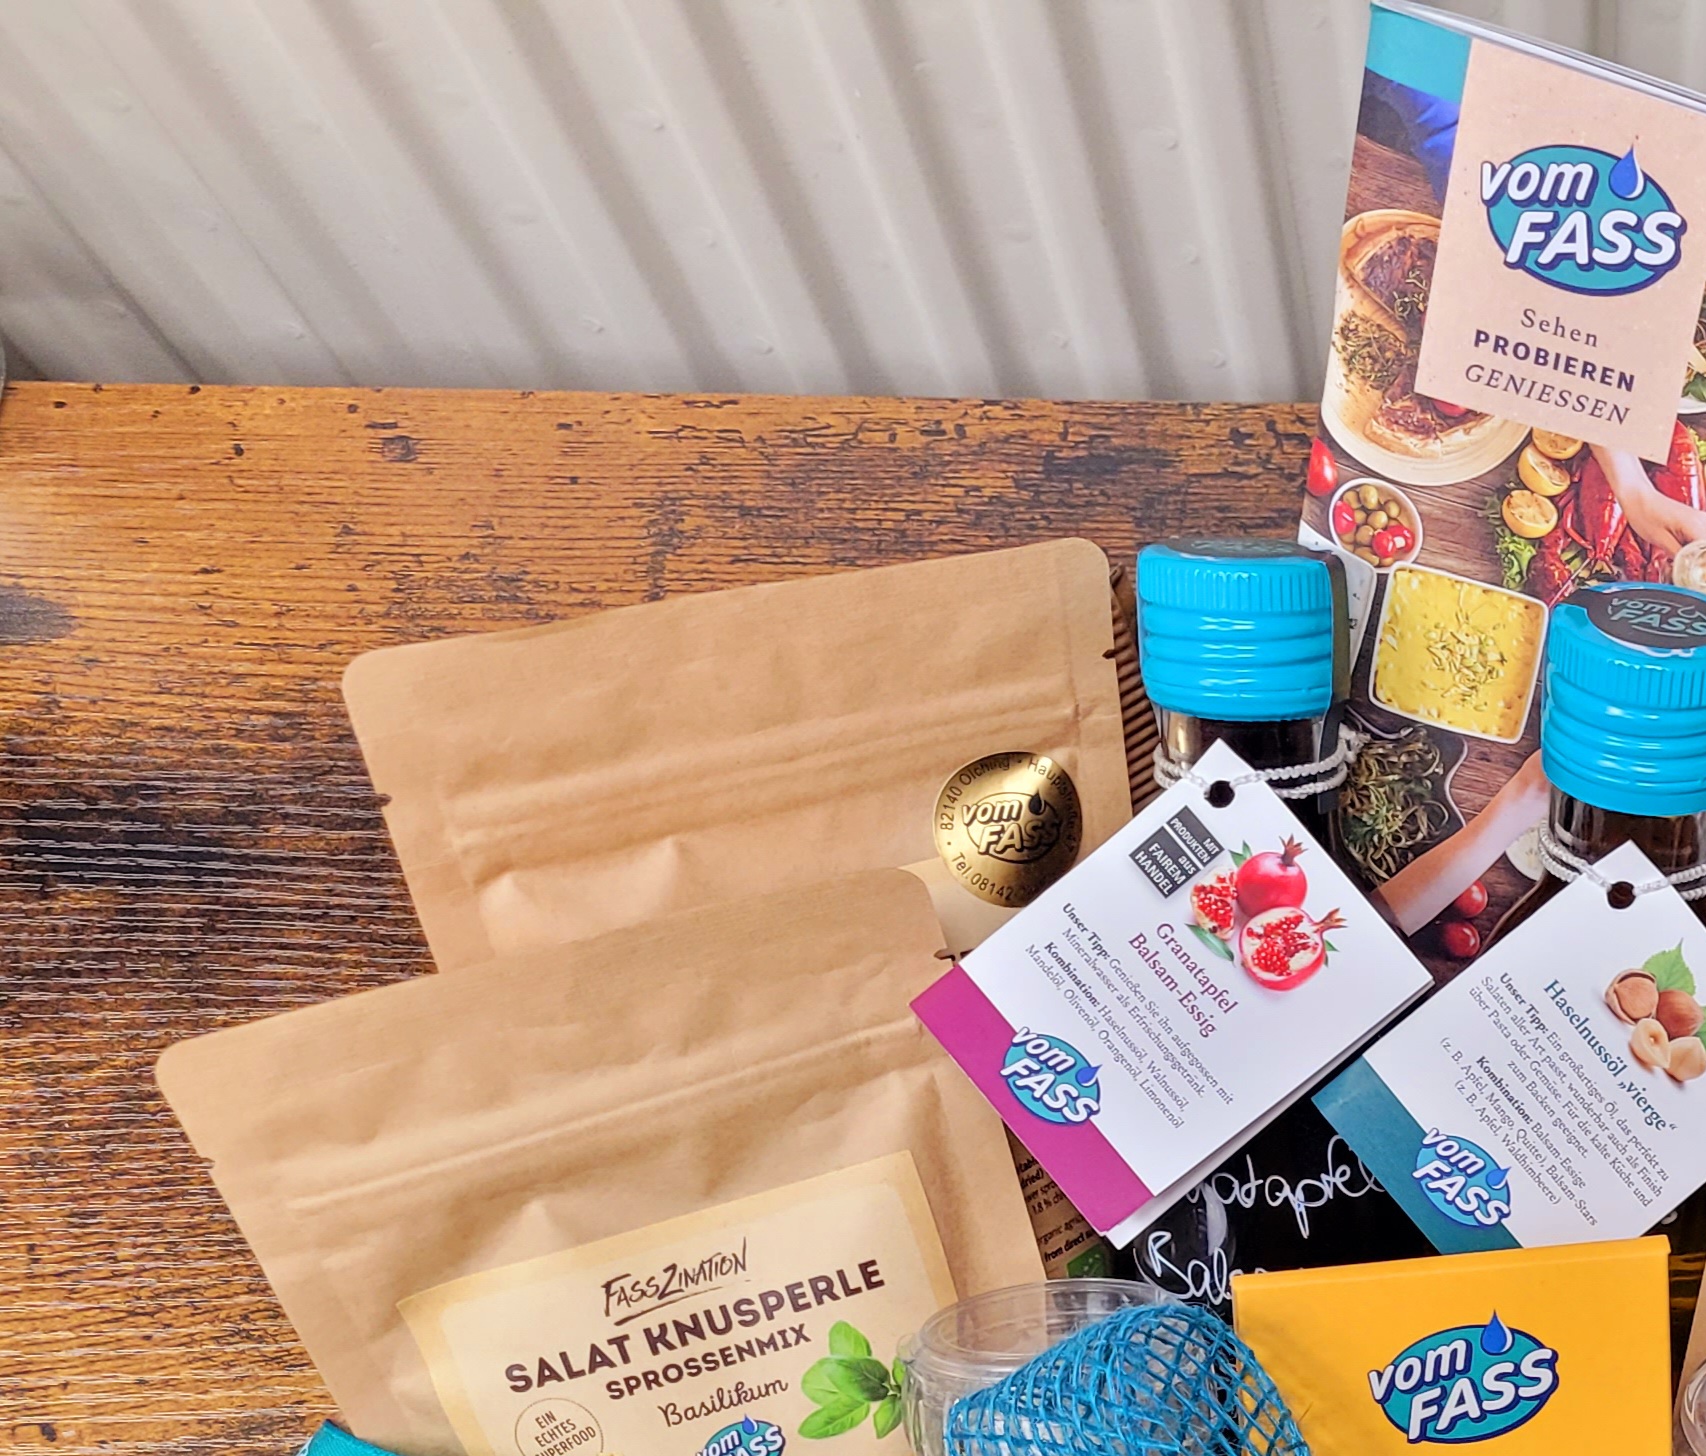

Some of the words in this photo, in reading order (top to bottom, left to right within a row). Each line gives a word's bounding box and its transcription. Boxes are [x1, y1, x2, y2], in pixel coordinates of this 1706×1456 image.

[1481, 161, 1598, 204] vom
[1505, 210, 1687, 270] FASS
[1521, 308, 1599, 348] Sehen
[1474, 330, 1635, 392] PROBIEREN
[1465, 364, 1631, 425] GENIESSEN
[1612, 598, 1671, 613] vom
[940, 786, 962, 830] 82140
[962, 800, 1023, 826] vom
[1148, 842, 1187, 885] FAIREM
[1169, 817, 1211, 863] PRODUKTEN
[1177, 855, 1197, 875] aus
[1202, 837, 1220, 855] MIT
[1134, 850, 1173, 895] HANDEL
[1061, 927, 1120, 994] Mineralwasser
[1115, 993, 1131, 1008] als
[1128, 932, 1217, 1039] Balsam-Essig
[1156, 923, 1239, 1015] Granatapfel
[1044, 941, 1101, 1008] Kombination:
[1097, 1004, 1149, 1064] Haselnussöl,
[1146, 1059, 1190, 1113] Walnussöl,
[1062, 902, 1089, 933] Unser
[1087, 931, 1111, 960] Tipp:
[1109, 958, 1147, 1004] Genießen
[1144, 1000, 1160, 1019] Sie
[1157, 1015, 1174, 1035] ihn
[1171, 1034, 1219, 1088] aufgegossen
[1215, 1087, 1234, 1105] mit
[1543, 979, 1628, 1078] Haselnussöl
[1011, 1027, 1077, 1074] vom
[1499, 972, 1527, 1005] Unser
[1525, 1003, 1549, 1034] Tipp:
[1546, 1031, 1563, 1052] Ein
[1558, 1051, 1606, 1104] großartiges
[1604, 1101, 1619, 1120] Öl,
[1615, 1118, 1632, 1136] das
[1626, 1135, 1660, 1170] perfekt
[1656, 1168, 1670, 1182] zu
[1000, 1058, 1101, 1126] FASS
[1475, 1055, 1534, 1125] Kombination:
[1530, 1121, 1586, 1189] Balsam-Essige
[1422, 1128, 1484, 1174] vom
[1411, 1160, 1511, 1227] FASS
[504, 1334, 633, 1394] SALAT
[645, 1258, 886, 1355] KNUSPERLE
[606, 1323, 811, 1400] SPROSSENMIX
[1368, 1332, 1472, 1403] vom
[534, 1410, 557, 1429] EIN
[657, 1375, 790, 1428] Basilikum
[1406, 1346, 1558, 1444] FASS
[534, 1417, 577, 1450] ECHTES
